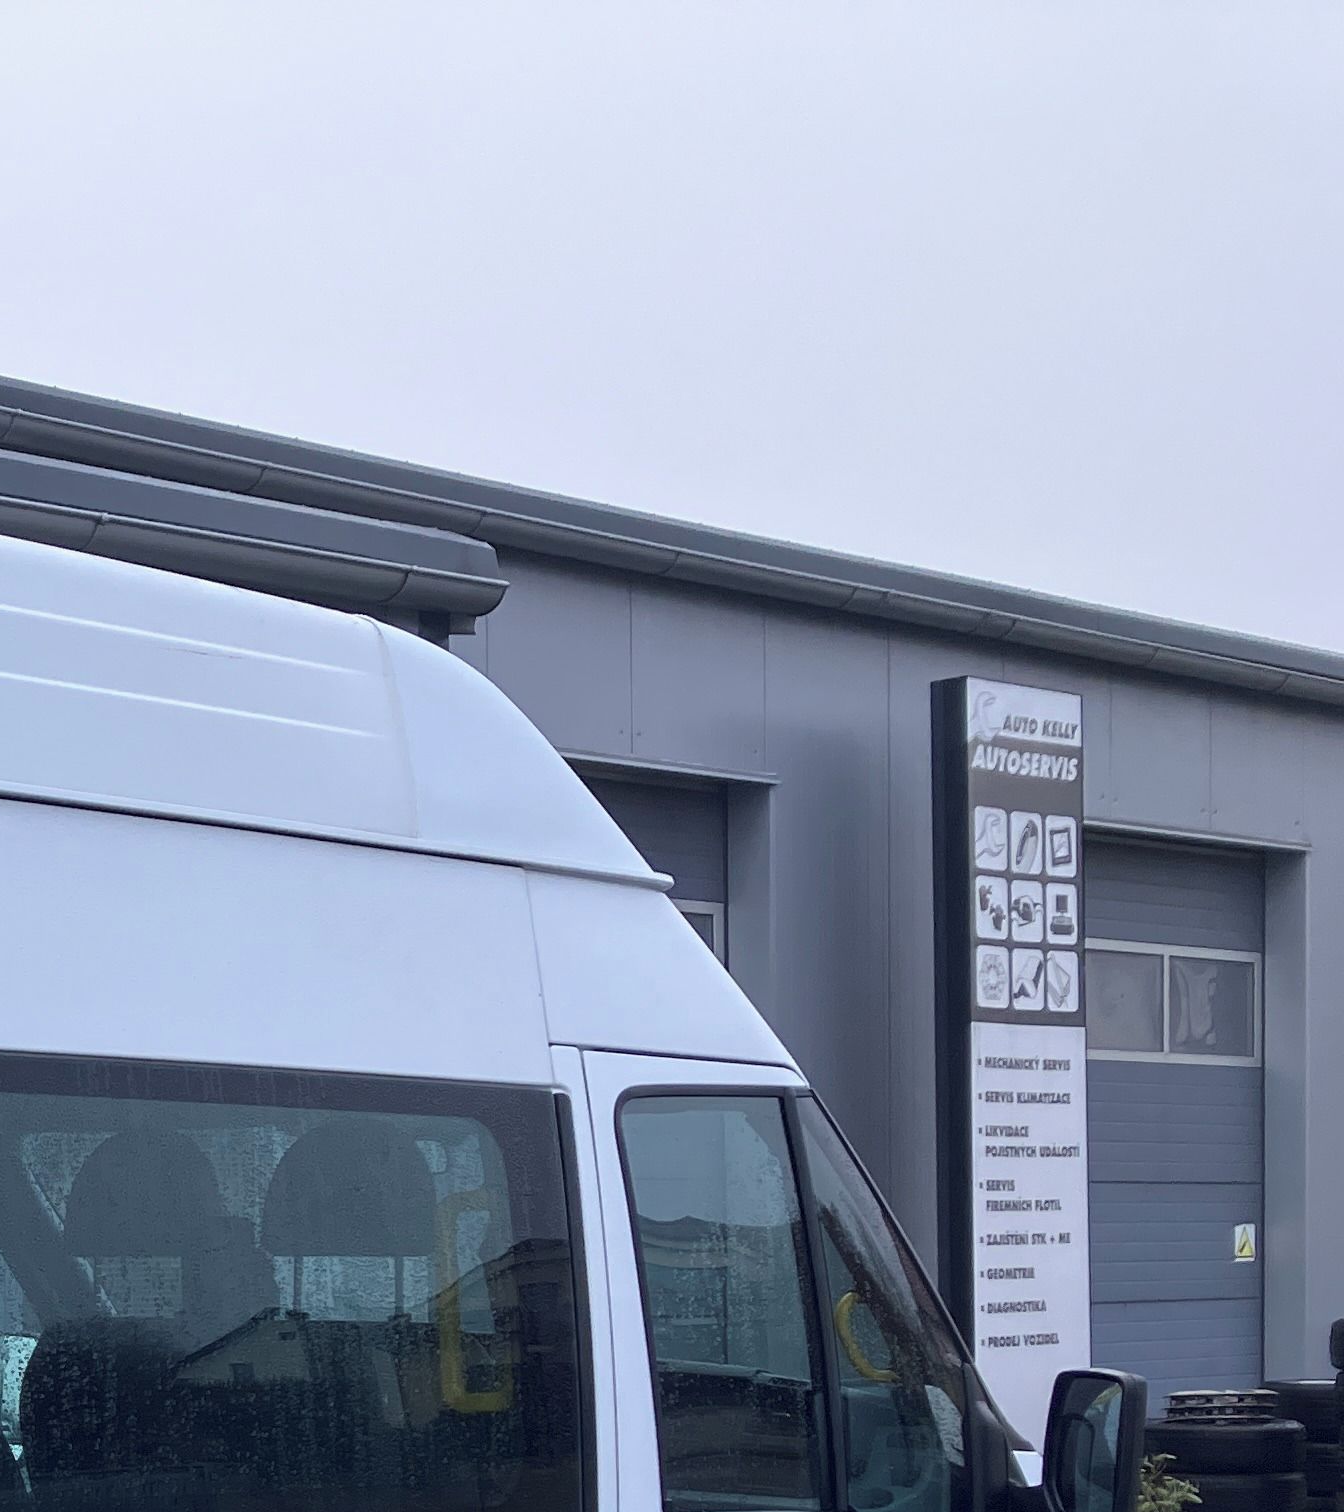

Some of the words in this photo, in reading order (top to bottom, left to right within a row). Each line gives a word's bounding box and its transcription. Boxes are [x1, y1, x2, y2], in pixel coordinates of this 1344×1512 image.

[1002, 713, 1039, 735] AUTO
[1041, 719, 1079, 740] KELLY
[971, 743, 1079, 782] AUTOSERVIS
[984, 1055, 1040, 1071] MECHANICKÝ
[1042, 1058, 1071, 1071] SERVIS
[985, 1091, 1014, 1103] SERVIS
[1016, 1091, 1071, 1105] KLIMATIZACE
[985, 1125, 1029, 1138] LIKVIDACE
[985, 1142, 1038, 1158] POJISTNÝCH
[986, 1180, 1016, 1192] SERVIS
[986, 1196, 1033, 1212] FIREMNÍCH
[1035, 1199, 1062, 1212] FLOTIL
[1031, 1233, 1047, 1245] STK
[986, 1267, 1035, 1280] GEOMETRIE
[987, 1299, 1047, 1314] DIAGNOSTIKA
[987, 1335, 1021, 1348] PRODEJ
[1023, 1333, 1060, 1347] VOZIDEL
